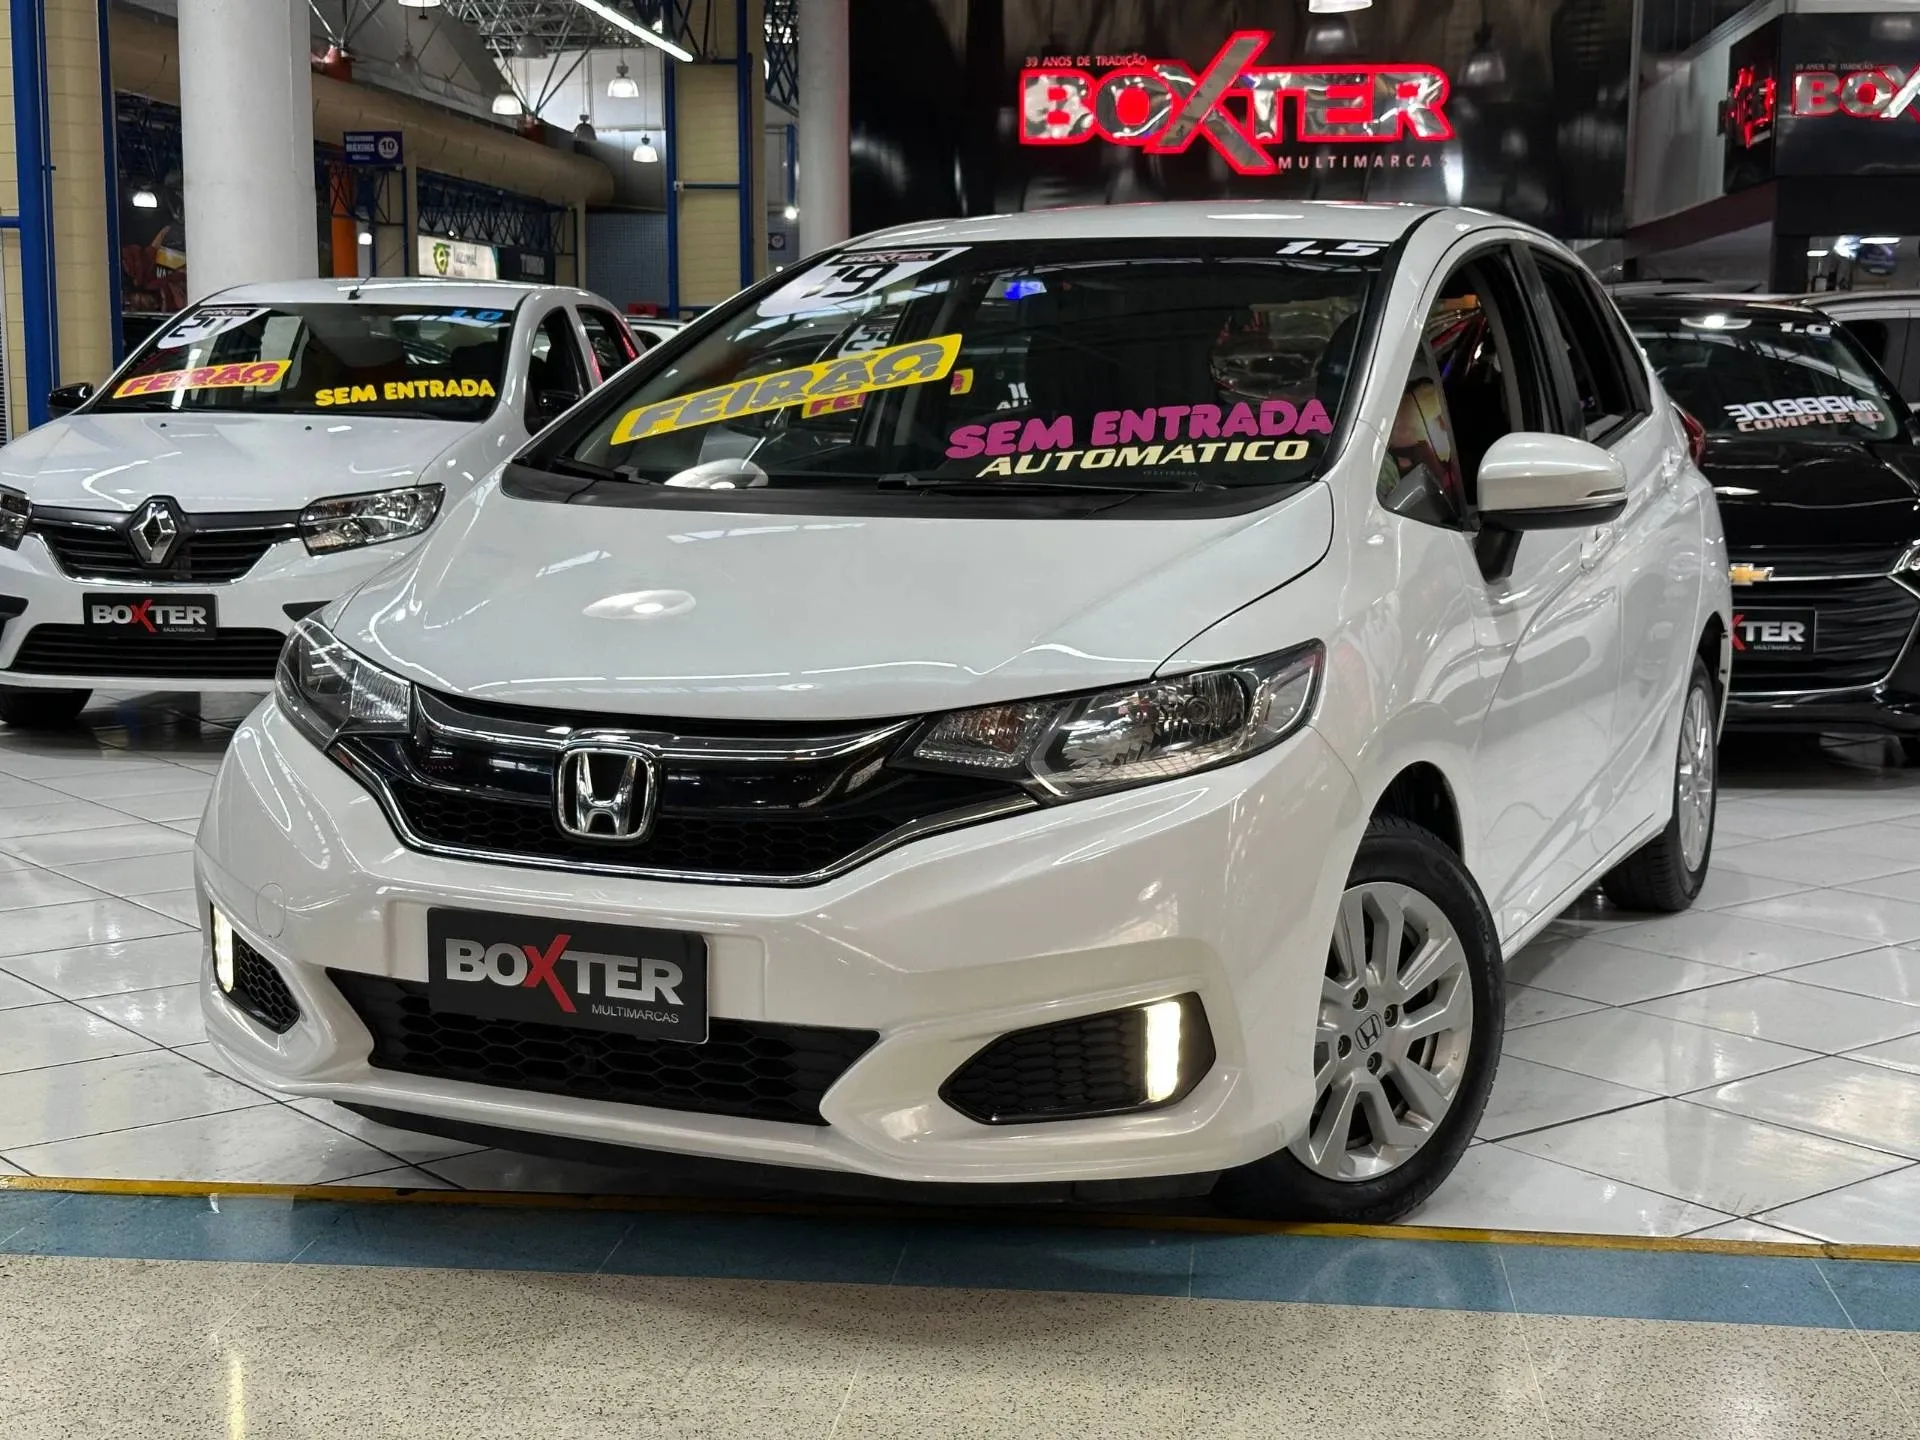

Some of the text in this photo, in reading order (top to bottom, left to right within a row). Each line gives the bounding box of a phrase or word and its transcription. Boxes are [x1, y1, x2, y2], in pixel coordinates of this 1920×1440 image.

[1025, 53, 1148, 67] 39 ANOS DE TRADIÇÃO
[1019, 30, 1455, 176] BOXTER
[381, 140, 395, 151] 10
[1275, 240, 1390, 256] 1.5
[1779, 321, 1832, 335] 1.0
[315, 379, 496, 406] SEM ENTRADA
[628, 342, 947, 440] FEIRÃO
[945, 398, 1334, 460] SEM ENTRADA
[1737, 411, 1886, 433] COMPLETO
[91, 598, 207, 633] BOXTER
[445, 933, 685, 1013] BOXTER
[591, 1003, 680, 1025] MULTIMARCAS
